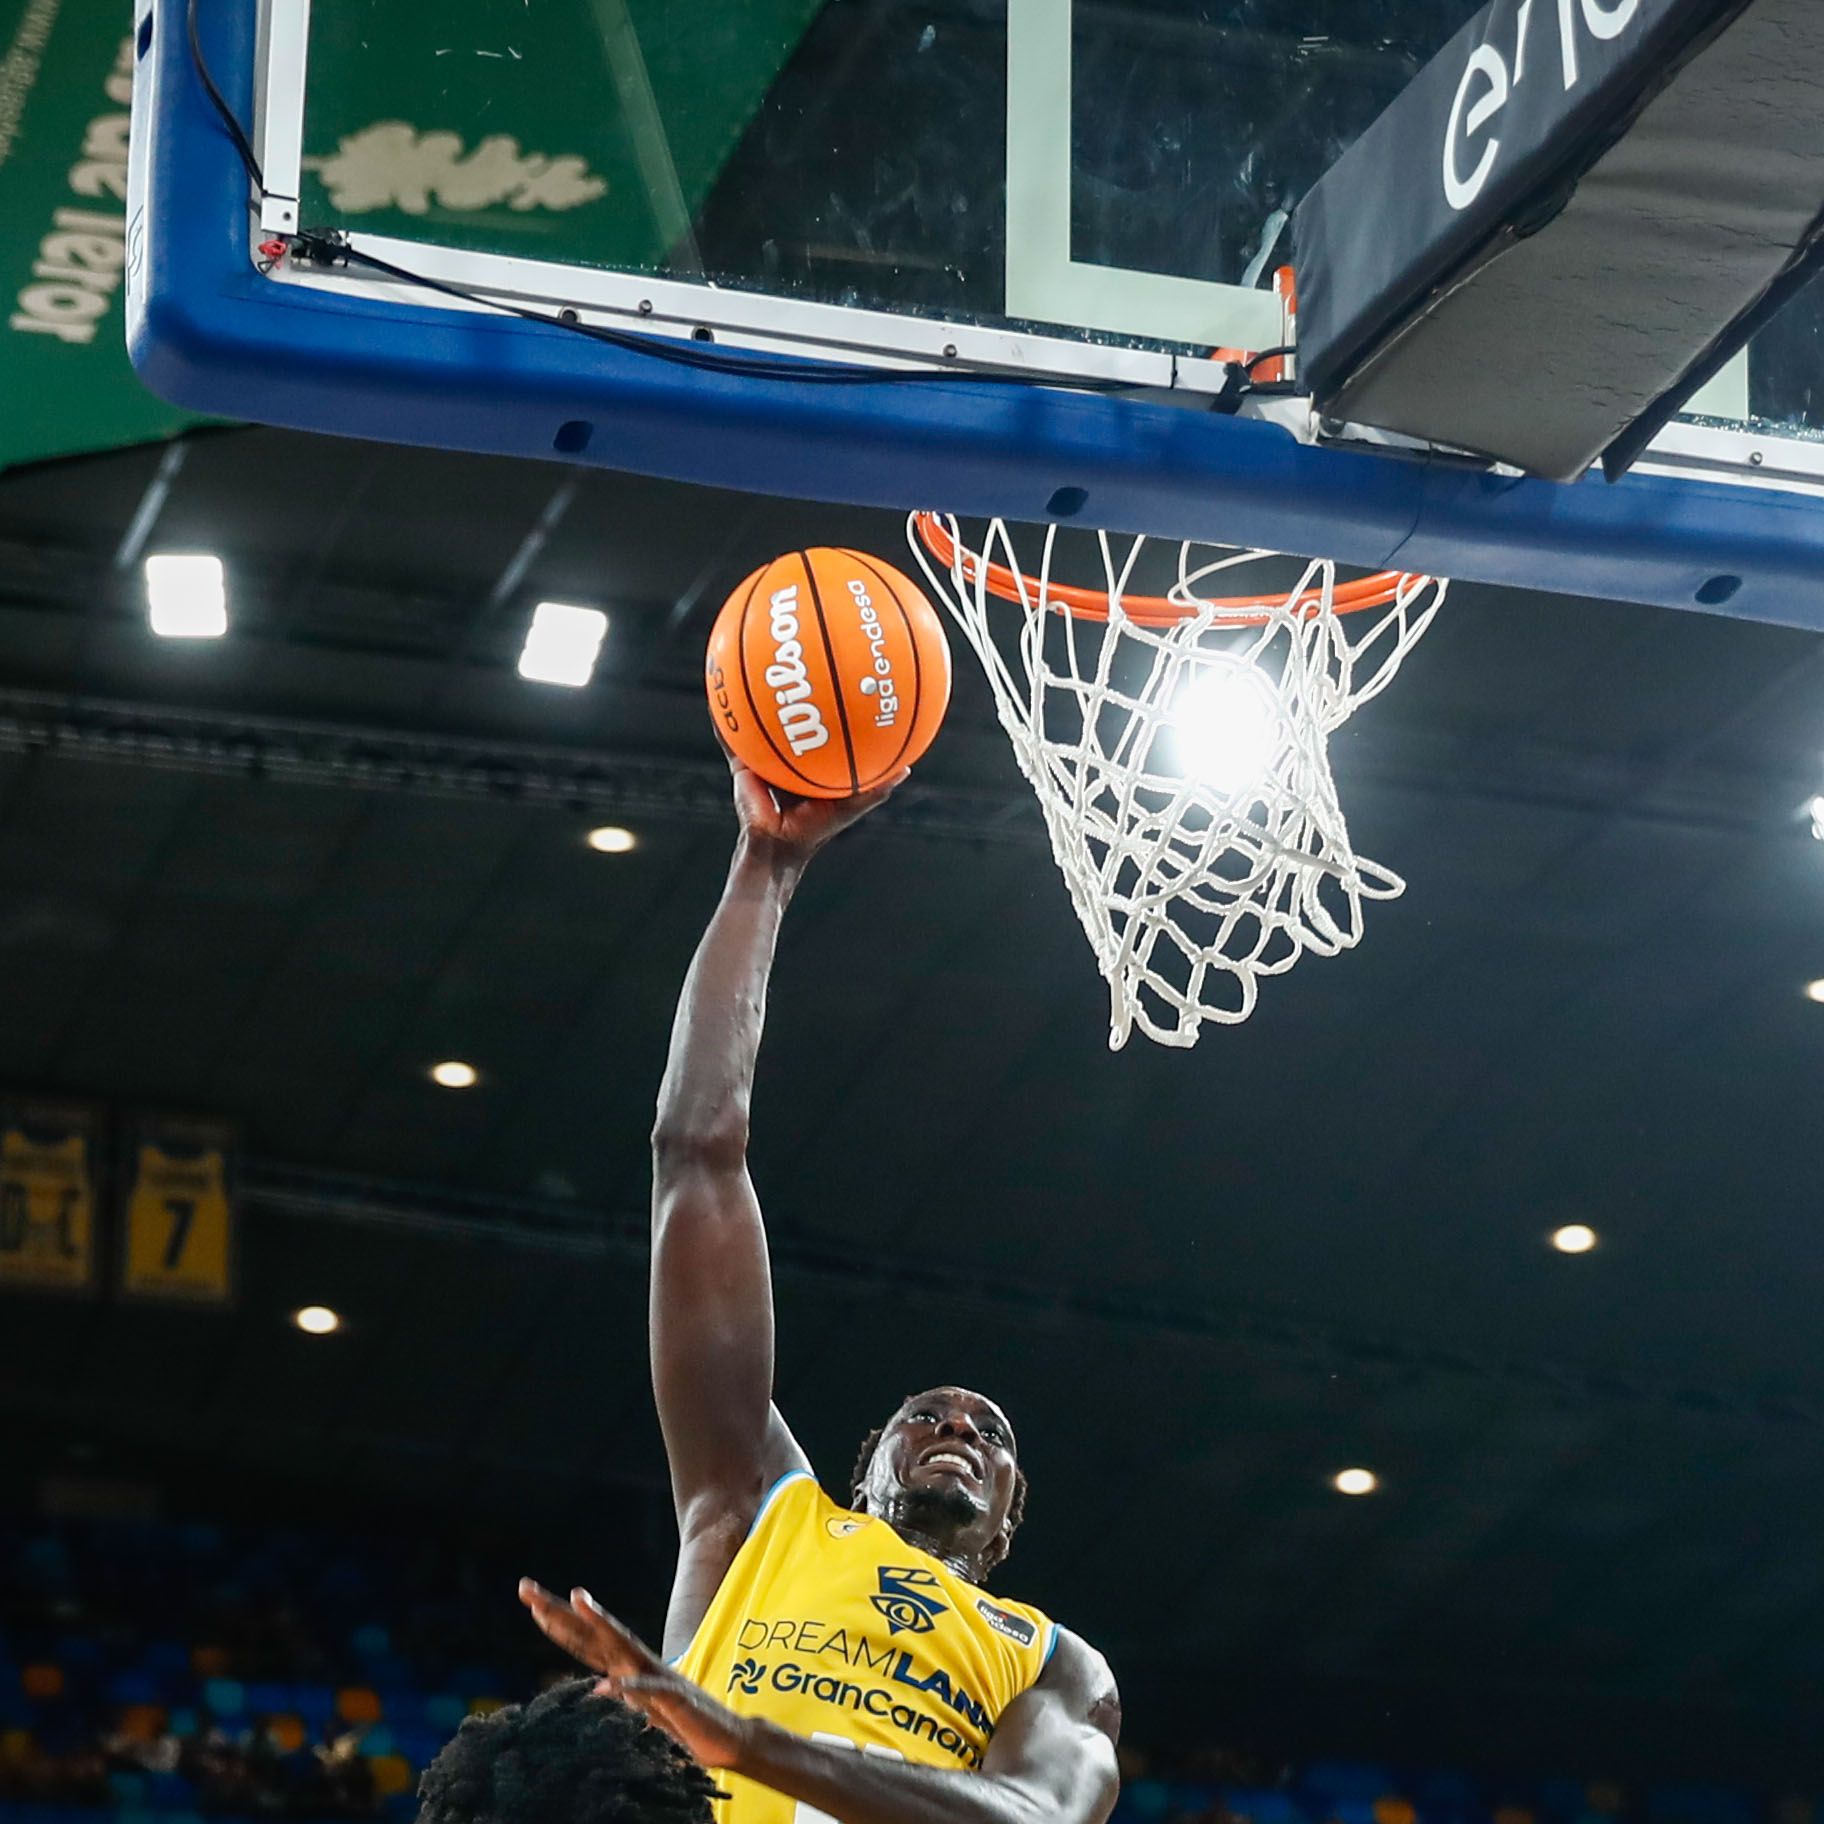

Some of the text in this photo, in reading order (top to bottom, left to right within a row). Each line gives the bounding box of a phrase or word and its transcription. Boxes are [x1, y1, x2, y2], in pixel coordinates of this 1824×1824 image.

[766, 584, 829, 757] Wilson
[847, 580, 899, 728] liga endesa
[160, 1199, 197, 1269] 7
